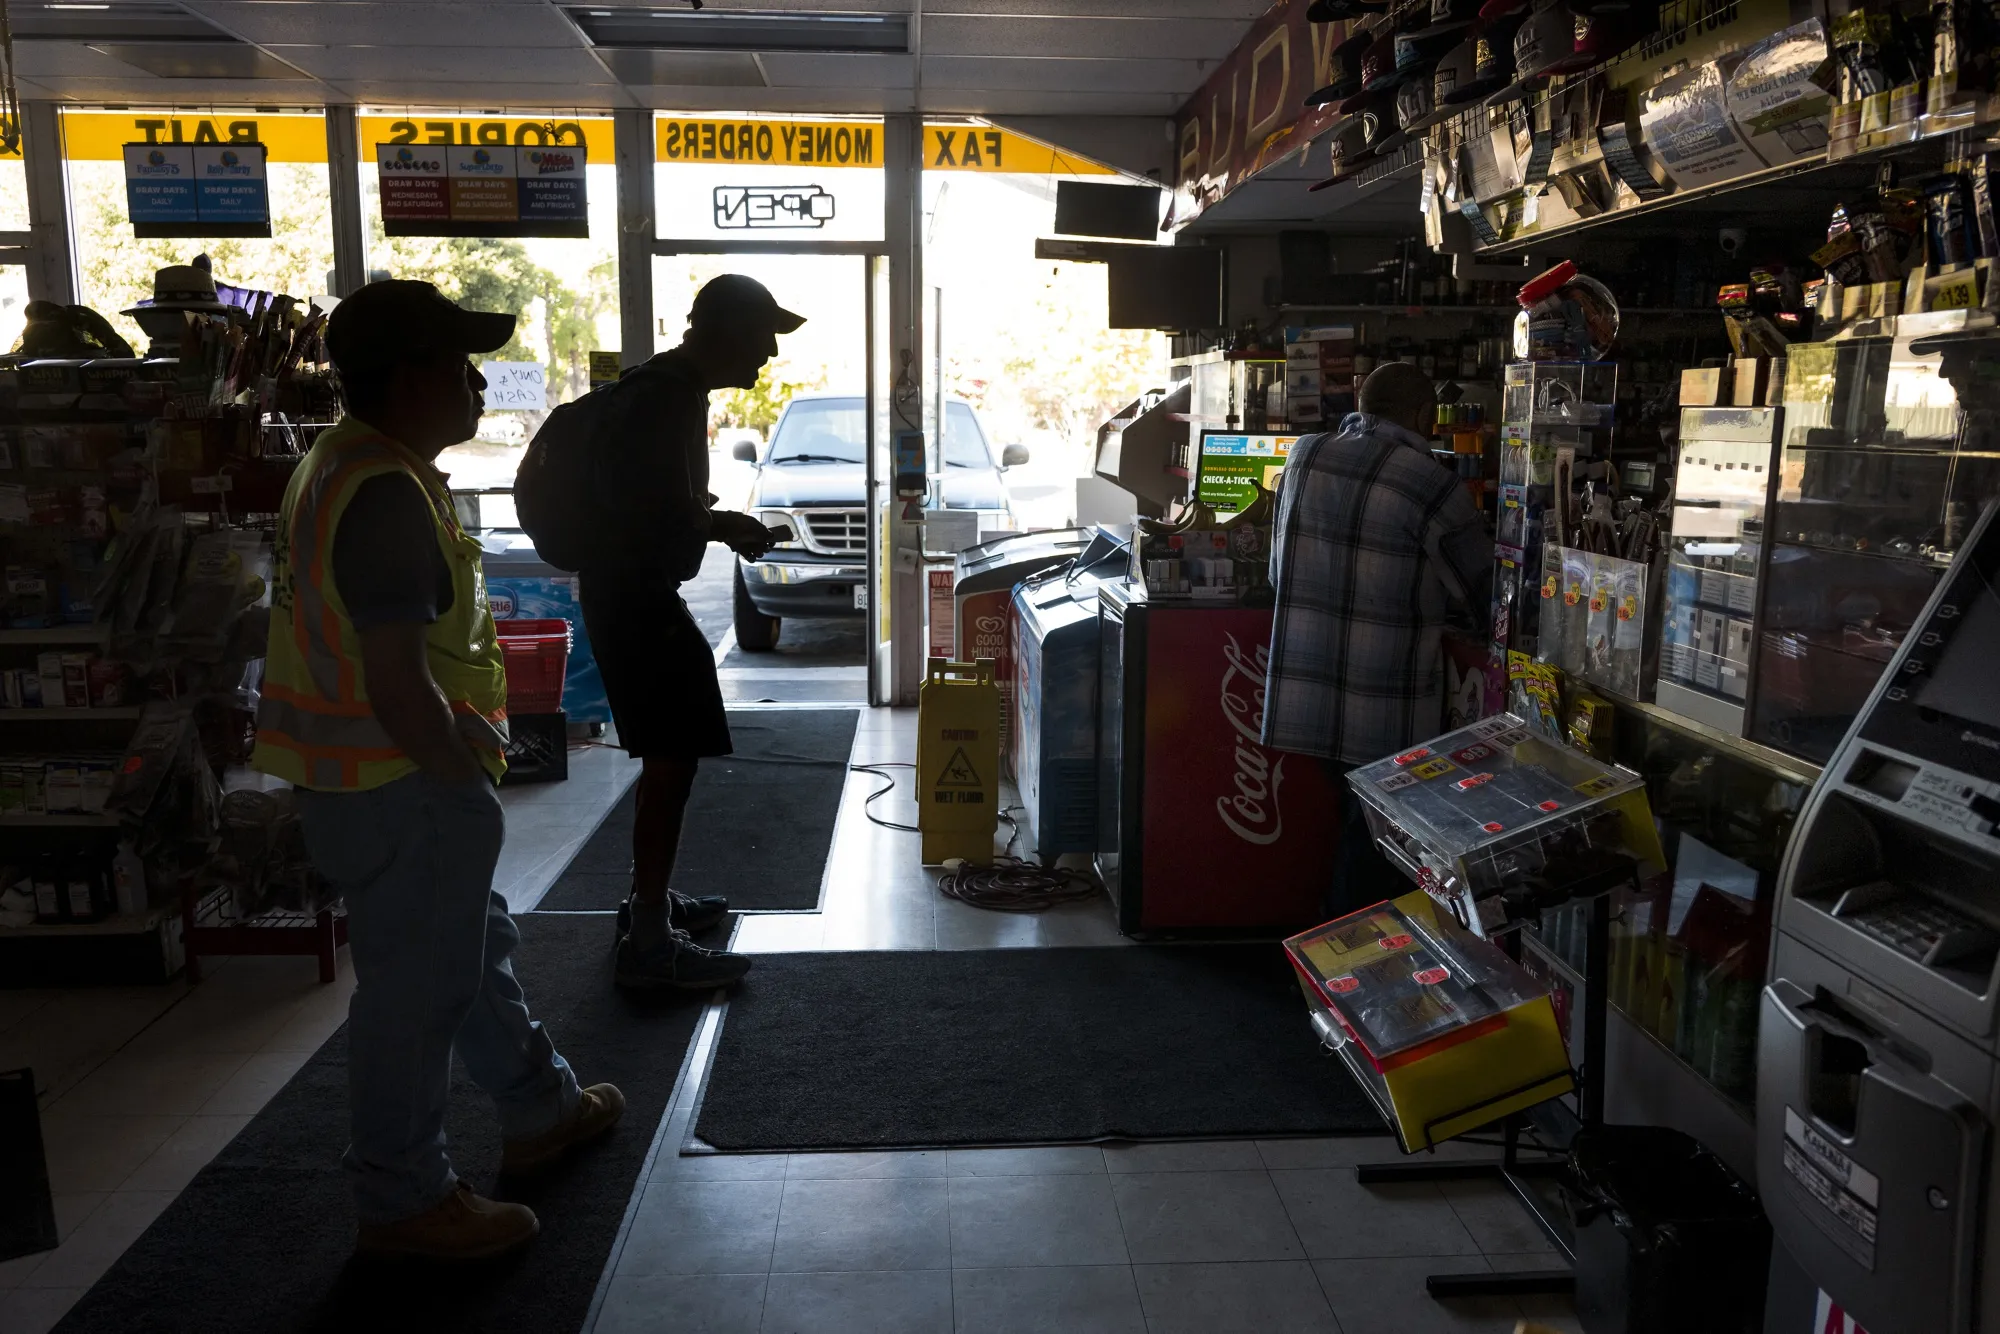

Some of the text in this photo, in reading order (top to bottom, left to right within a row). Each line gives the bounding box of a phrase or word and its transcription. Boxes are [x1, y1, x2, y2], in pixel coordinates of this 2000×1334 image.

[388, 180, 412, 188] DRAW
[526, 181, 551, 189] DRAW
[460, 192, 508, 200] WEDNESDAYS
[472, 201, 514, 209] SATURDAYS
[490, 600, 511, 612] stlé
[975, 634, 1004, 646] GOOD
[971, 646, 1009, 658] HUMOR
[934, 790, 985, 804] WET FLOOR
